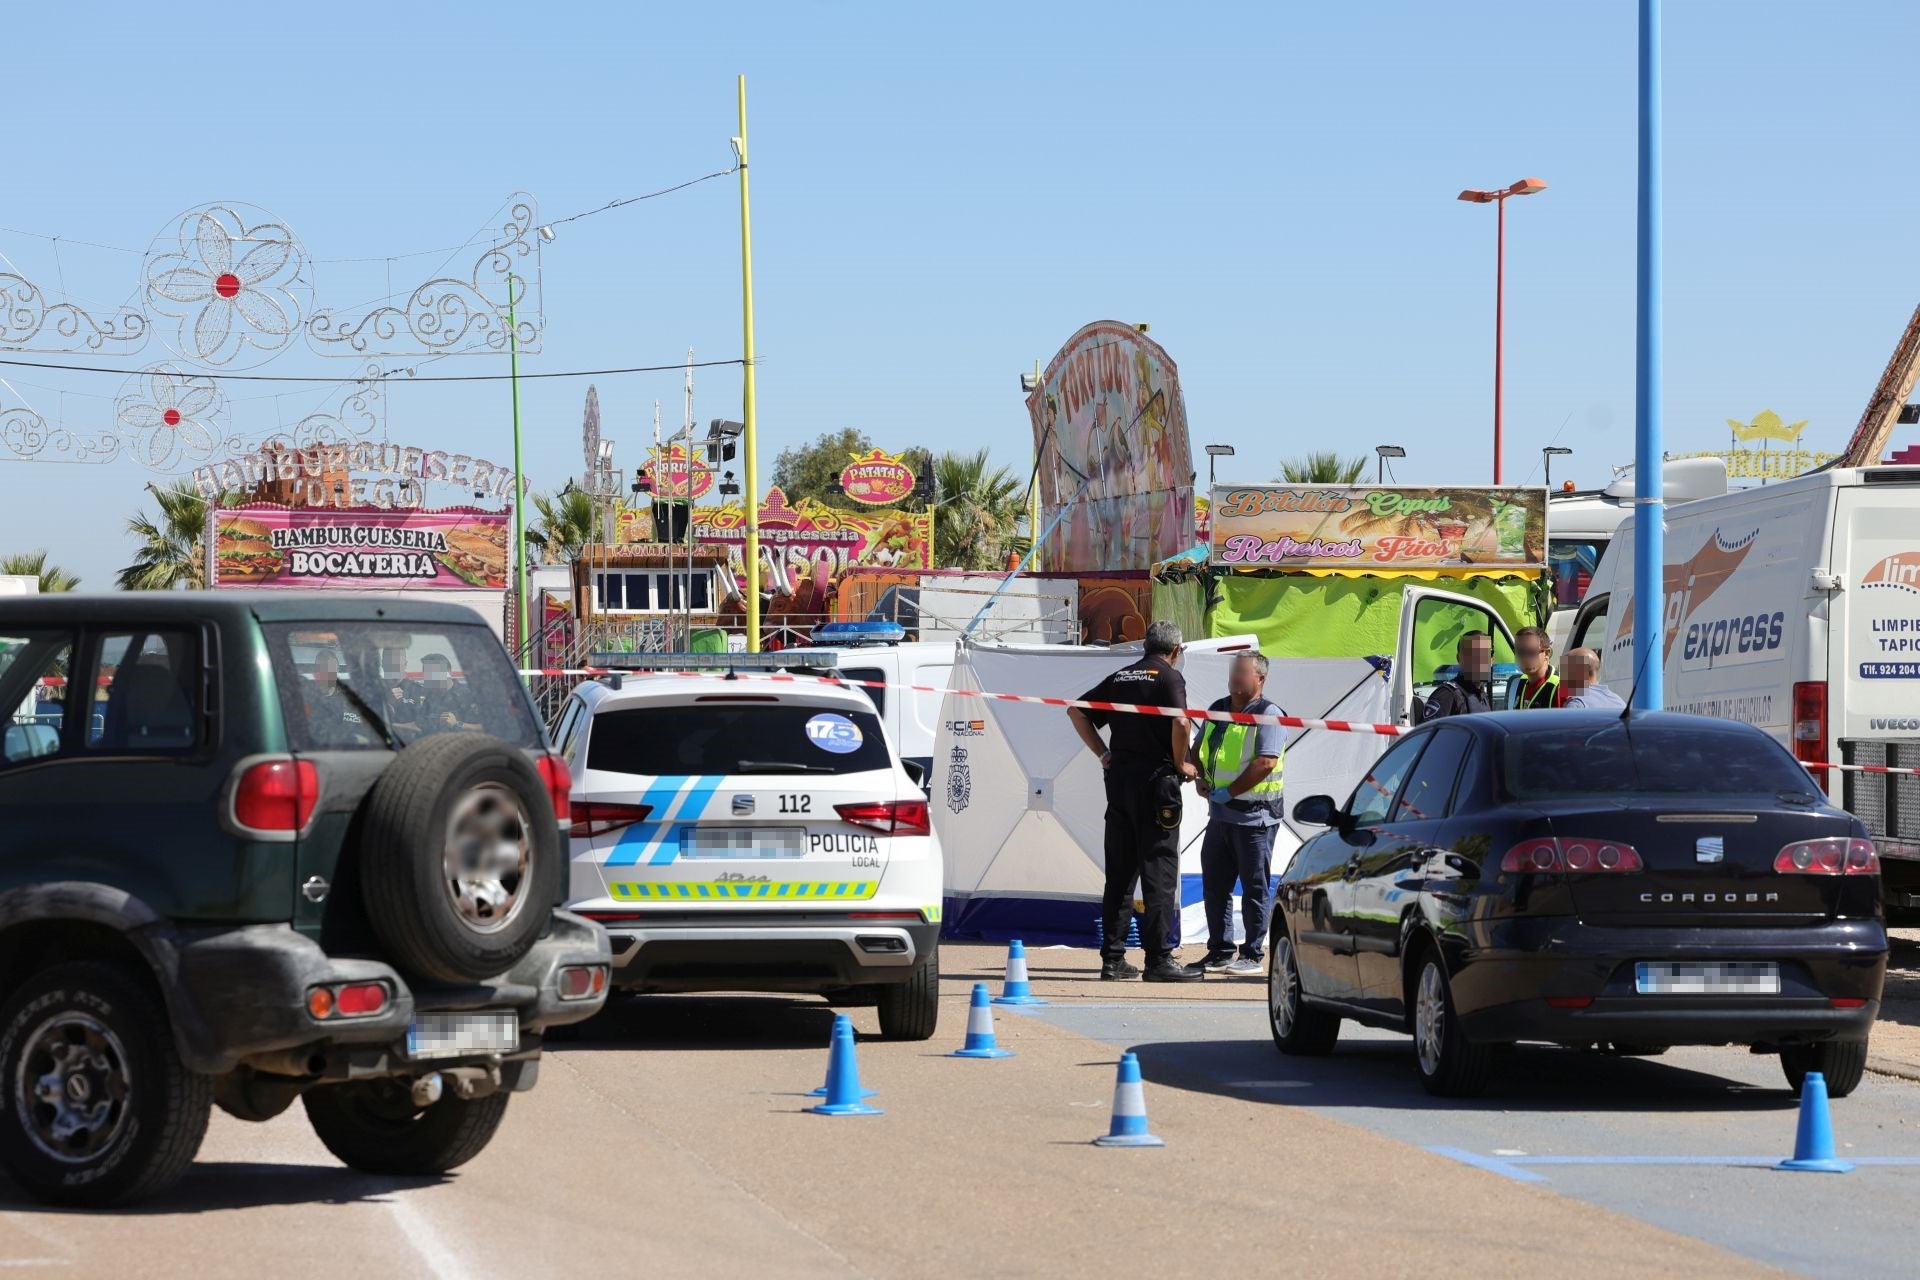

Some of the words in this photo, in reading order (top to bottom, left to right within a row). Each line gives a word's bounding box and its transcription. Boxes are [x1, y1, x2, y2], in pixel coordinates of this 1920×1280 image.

[193, 440, 527, 499] HAMBURGUESERIA
[849, 466, 904, 480] PATATAS
[307, 477, 423, 509] DIEGO
[1220, 489, 1352, 517] Botellón
[1365, 491, 1453, 517] Copas
[272, 527, 449, 551] HAMBURGUESERIA
[1222, 534, 1365, 562] Refrescos
[290, 553, 437, 577] BOCATERIA
[1683, 611, 1784, 670] express
[1880, 664, 1896, 675] 924
[1899, 664, 1915, 675] 204
[1870, 718, 1920, 730] IVECO
[779, 794, 811, 813] 112
[811, 834, 879, 853] POLICIA
[852, 857, 881, 868] LOCAL
[1640, 893, 1779, 902] CORDOBA
